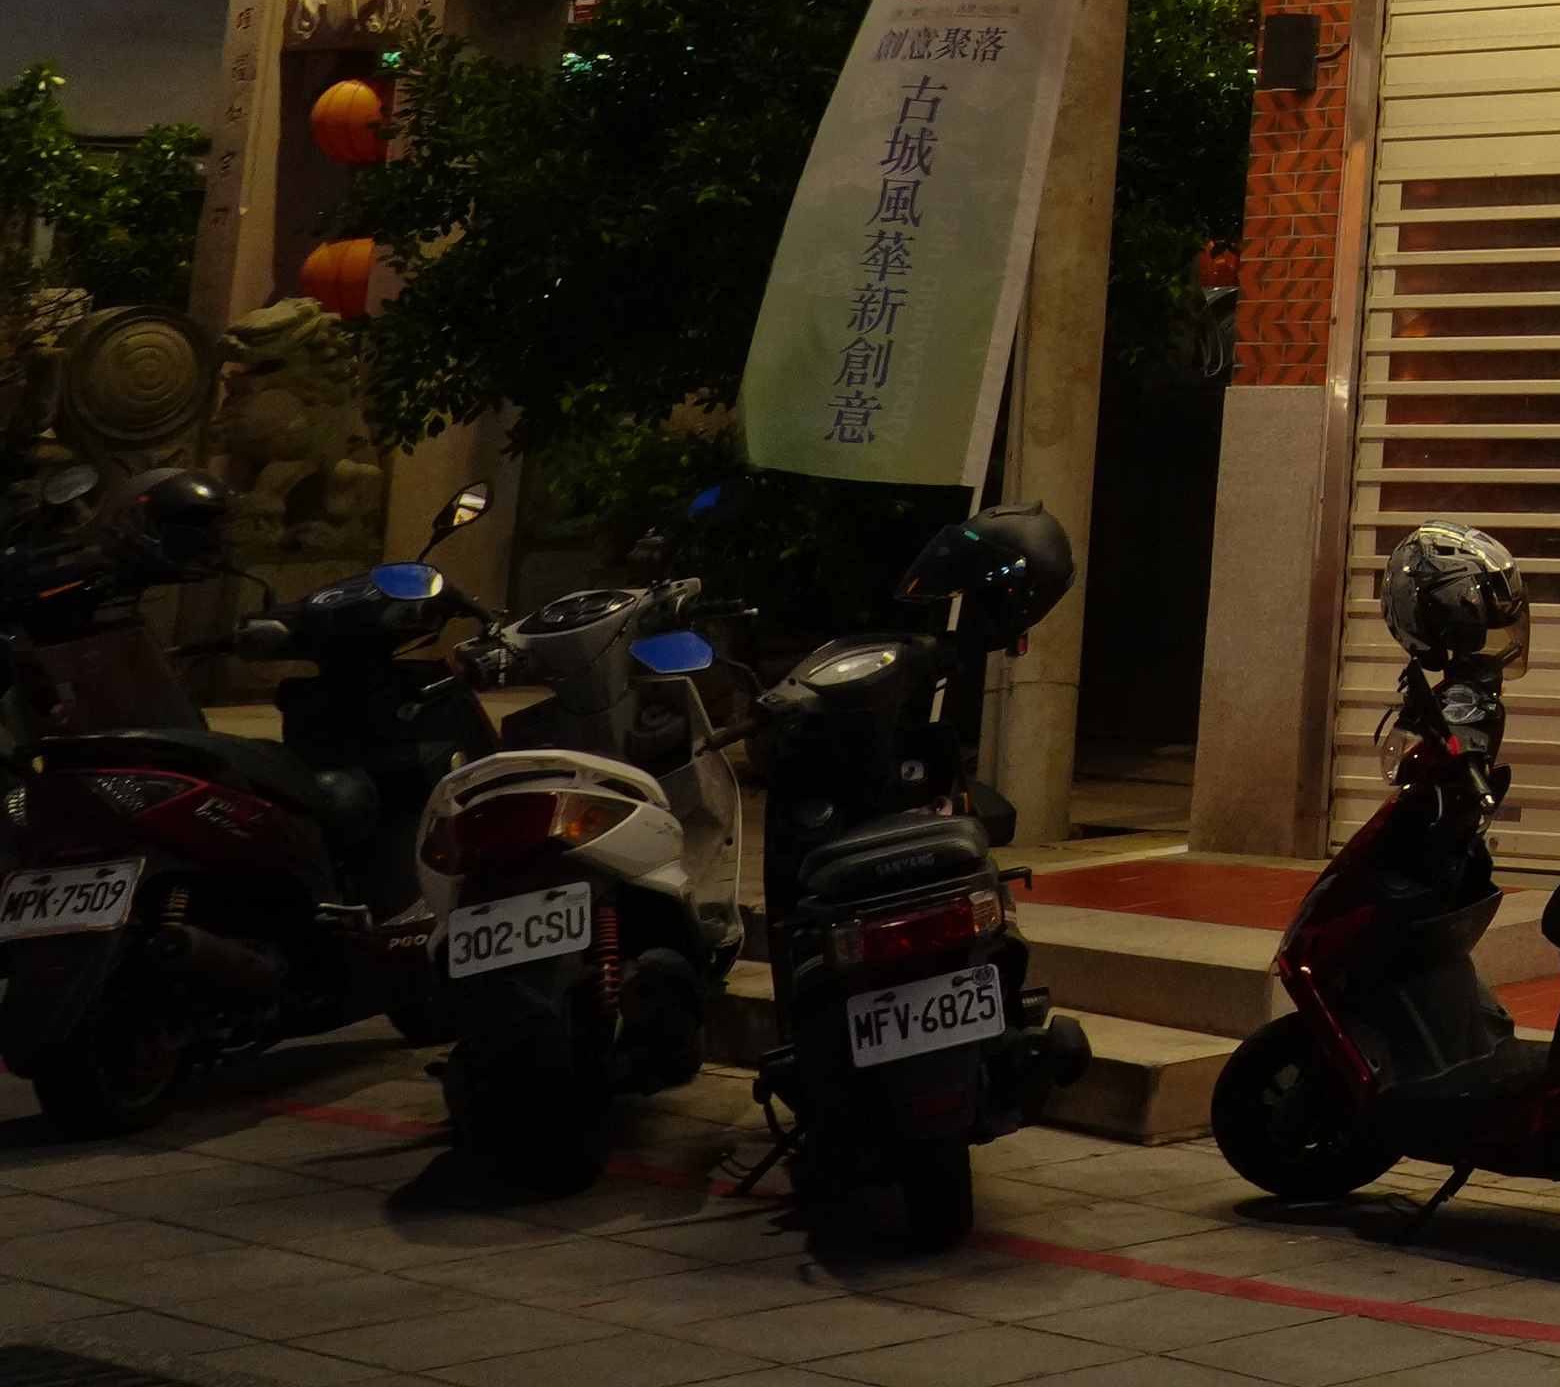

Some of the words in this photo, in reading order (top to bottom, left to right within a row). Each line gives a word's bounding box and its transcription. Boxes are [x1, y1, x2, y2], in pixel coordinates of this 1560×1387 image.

[874, 27, 1009, 63] 創意聚落
[823, 74, 948, 445] 古城風華新創意
